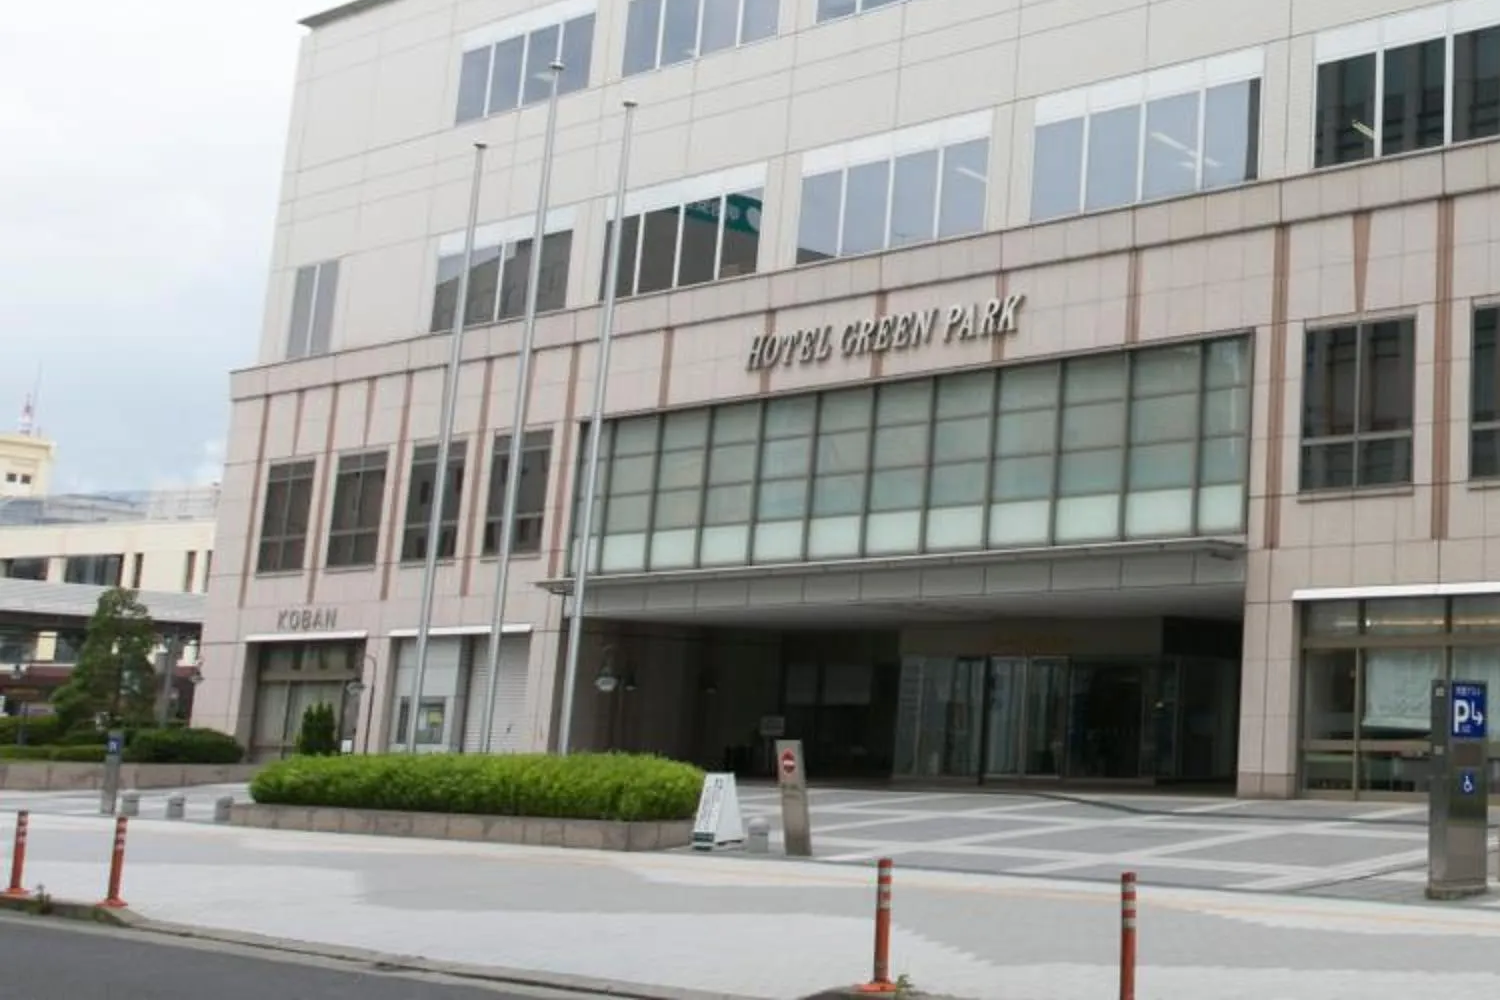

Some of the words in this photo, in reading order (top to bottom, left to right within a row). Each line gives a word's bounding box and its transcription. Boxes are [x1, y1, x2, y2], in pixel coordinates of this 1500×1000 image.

[747, 324, 832, 371] HOTEL
[840, 308, 937, 357] GREEN
[944, 294, 1024, 343] PARK
[276, 607, 338, 630] KOBAN
[1454, 699, 1470, 733] P
